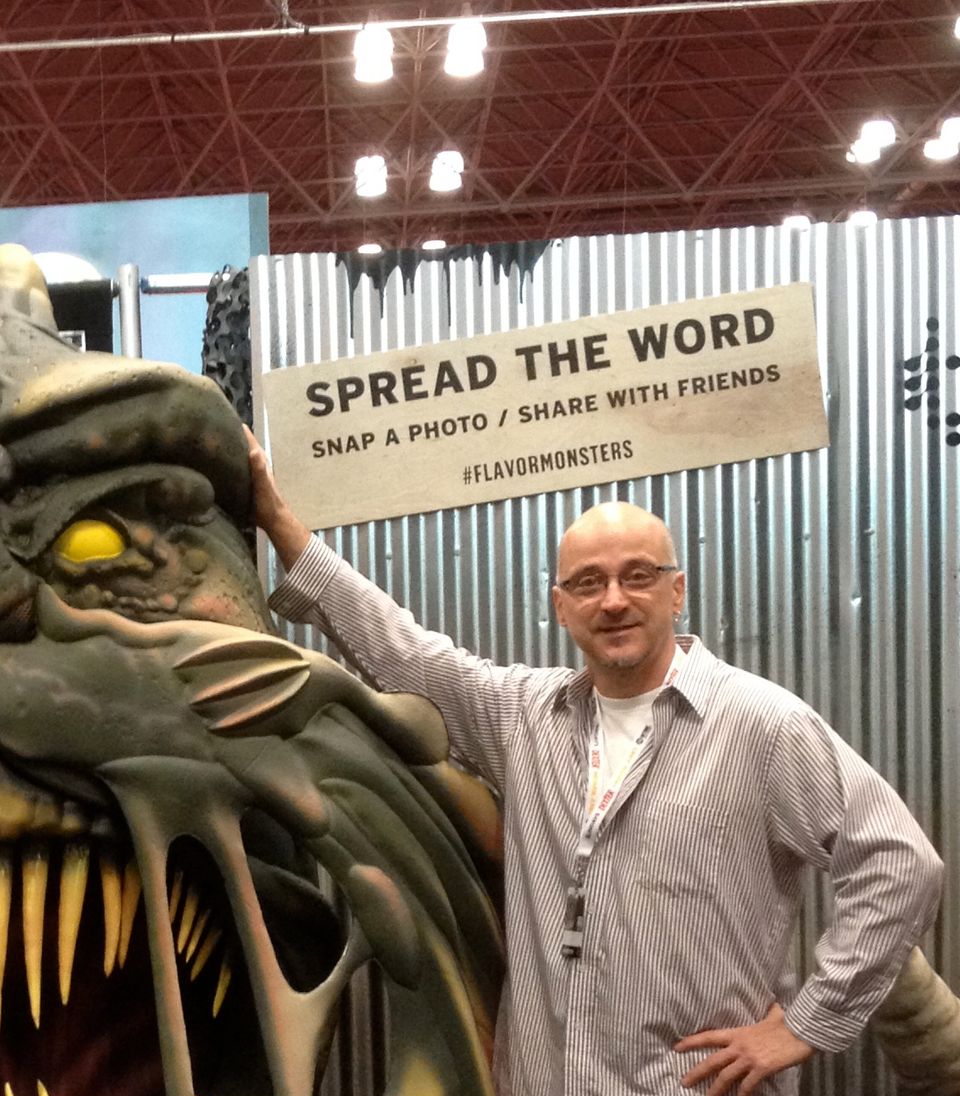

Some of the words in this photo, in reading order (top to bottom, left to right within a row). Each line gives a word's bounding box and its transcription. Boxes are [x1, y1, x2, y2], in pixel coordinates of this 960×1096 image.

[306, 355, 497, 418] SPREAD
[515, 333, 611, 381] THE
[628, 308, 775, 363] WORD
[312, 432, 375, 458] SNAP
[385, 428, 400, 446] A
[409, 413, 488, 442] PHOTO
[498, 409, 508, 427] /
[518, 394, 599, 423] SHARE
[607, 383, 669, 409] WITH
[678, 364, 781, 397] FRIENDS
[463, 440, 634, 485] #FLAVORMONSTERS
